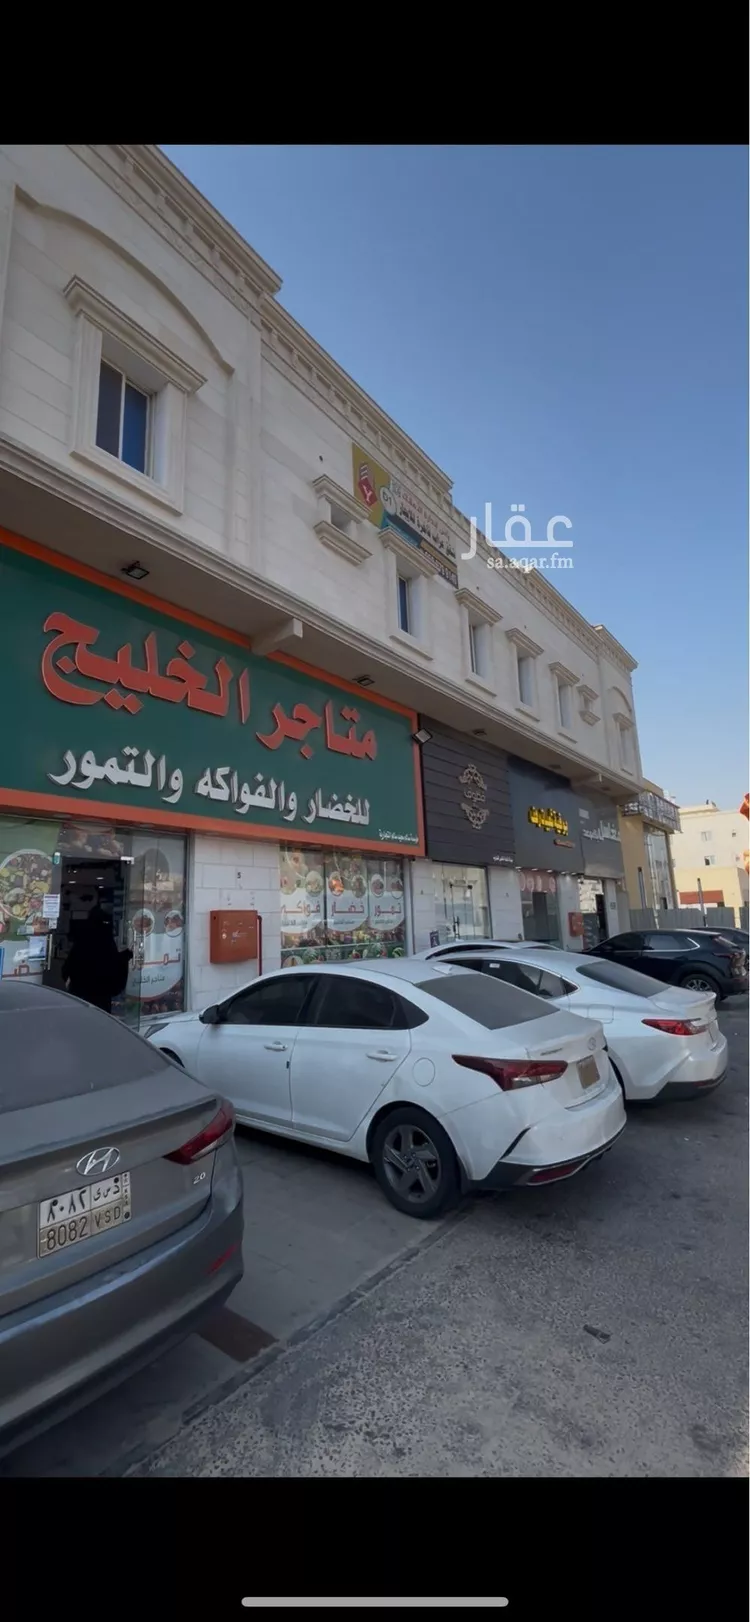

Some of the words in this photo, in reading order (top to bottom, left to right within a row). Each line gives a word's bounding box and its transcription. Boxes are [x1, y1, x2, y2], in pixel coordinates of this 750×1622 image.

[41, 612, 250, 722] الخليج
[256, 700, 379, 760] متاجر
[48, 746, 184, 804] والتمور
[195, 766, 298, 824] والفواكه
[303, 787, 370, 826] للخضار
[236, 871, 242, 879] 5
[330, 900, 364, 917] خضار
[47, 1216, 88, 1250] 8082
[94, 1205, 122, 1229] VSD
